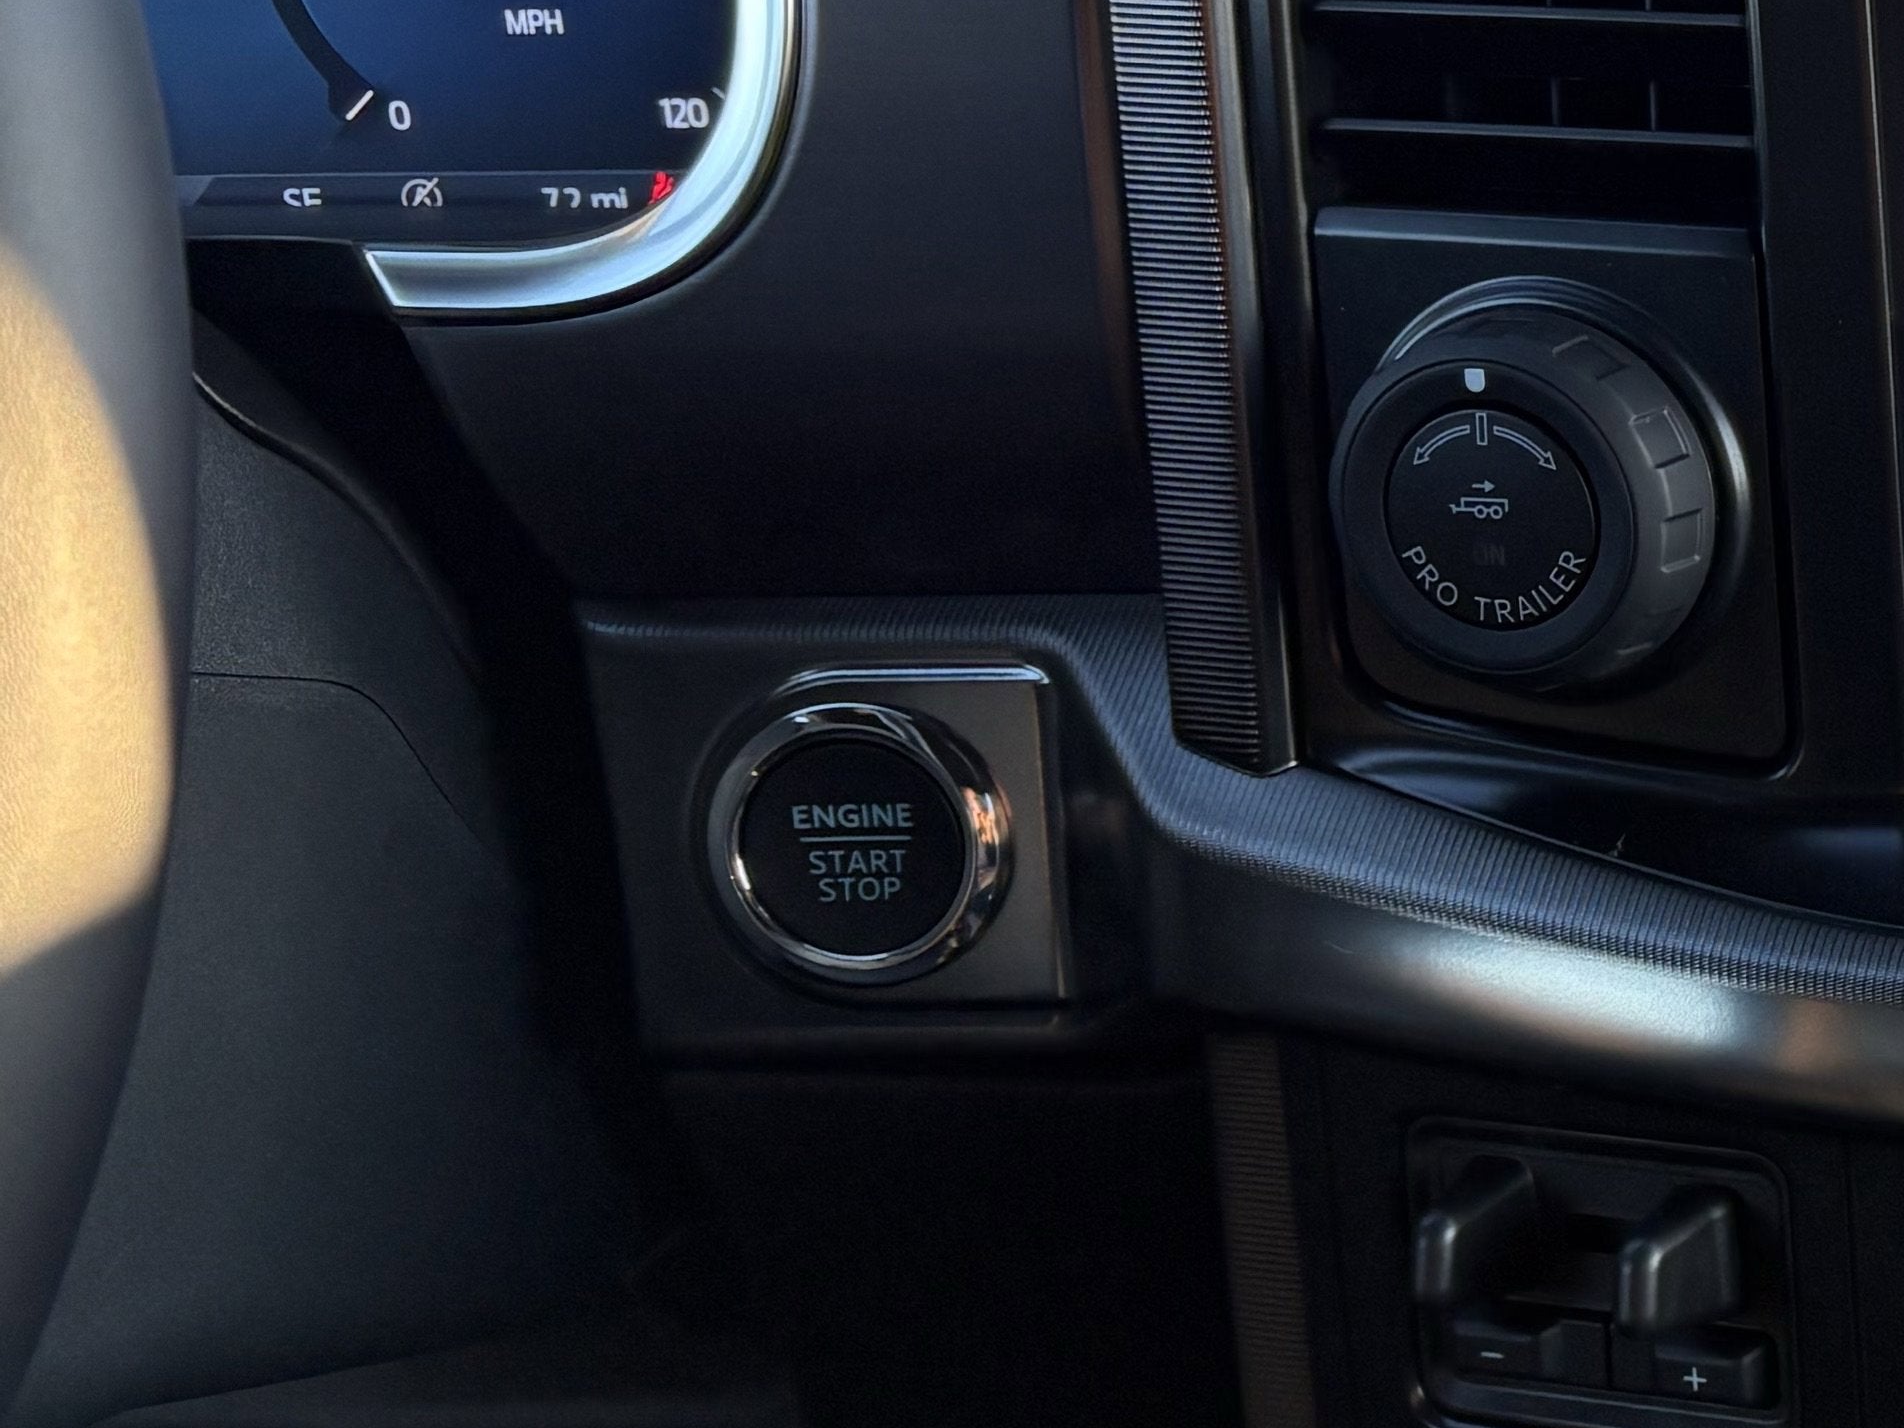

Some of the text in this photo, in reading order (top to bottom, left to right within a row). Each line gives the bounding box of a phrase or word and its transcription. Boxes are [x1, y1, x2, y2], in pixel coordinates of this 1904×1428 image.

[504, 8, 565, 37] MPH
[388, 100, 413, 131] 0
[658, 96, 711, 131] 120
[1402, 545, 1587, 623] PRO TRAILER
[791, 803, 914, 830] ENGINE
[809, 850, 906, 875] START
[819, 876, 902, 902] STOP
